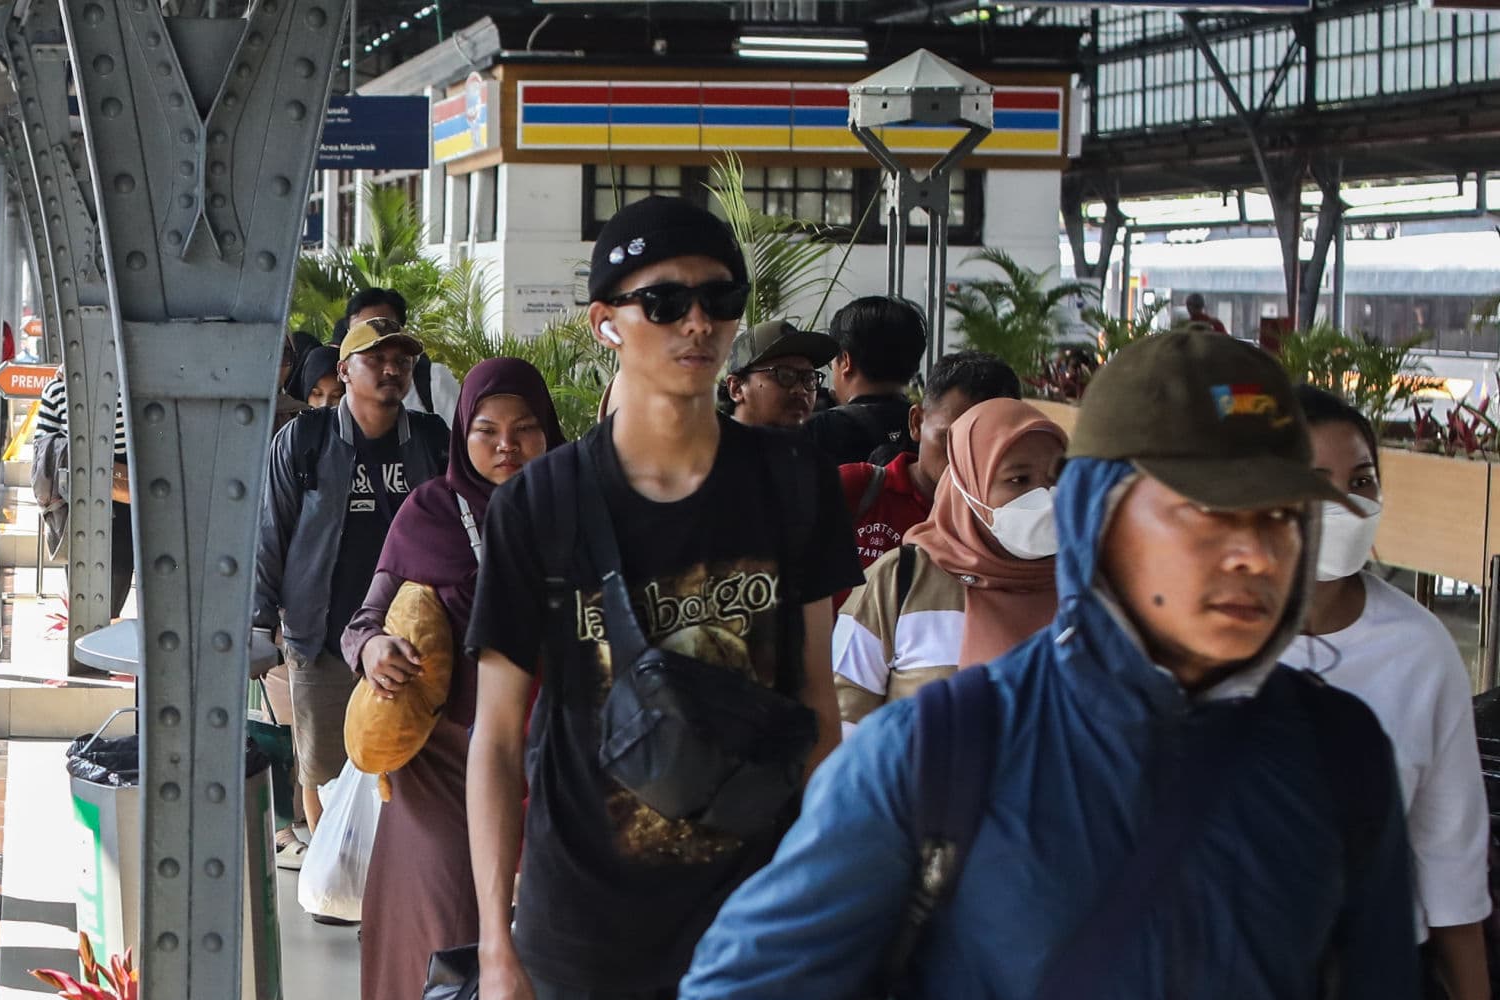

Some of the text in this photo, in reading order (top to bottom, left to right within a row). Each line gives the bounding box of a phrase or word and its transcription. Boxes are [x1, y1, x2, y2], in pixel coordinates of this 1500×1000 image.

[320, 143, 376, 151] Area Merokok
[857, 522, 901, 545] PORTER
[574, 581, 681, 640] lab
